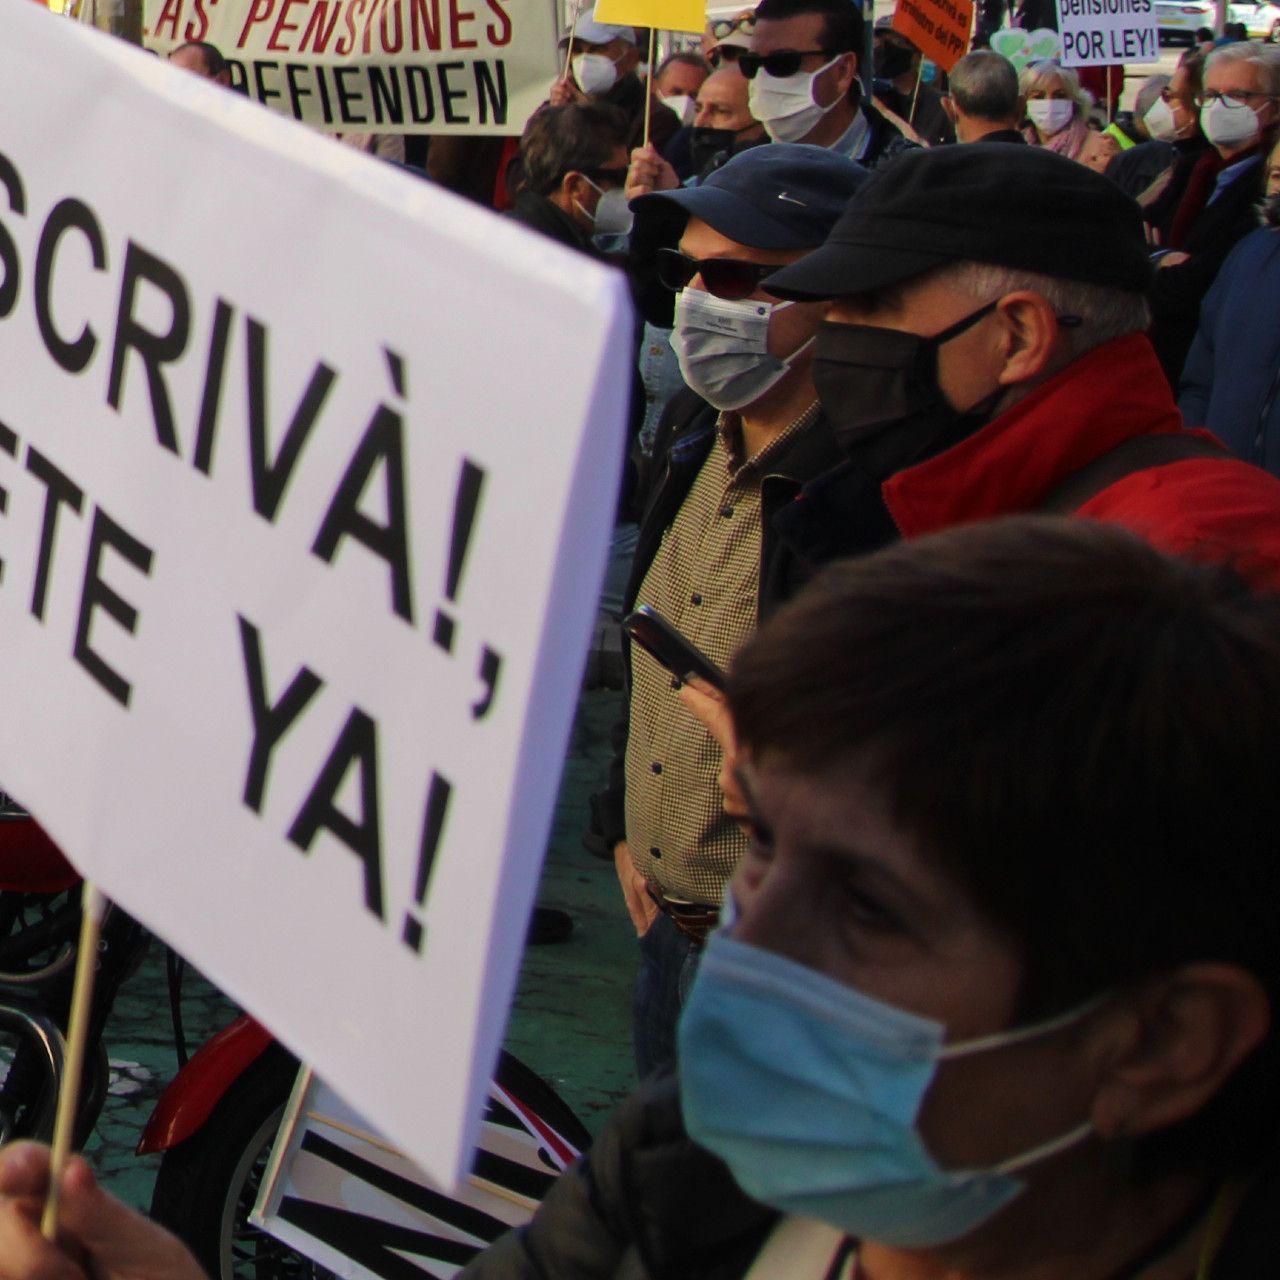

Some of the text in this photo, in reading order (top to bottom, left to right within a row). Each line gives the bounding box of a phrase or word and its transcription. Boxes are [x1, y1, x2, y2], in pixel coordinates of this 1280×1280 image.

[1063, 28, 1156, 60] POR LEY!
[236, 611, 454, 957] YA!
